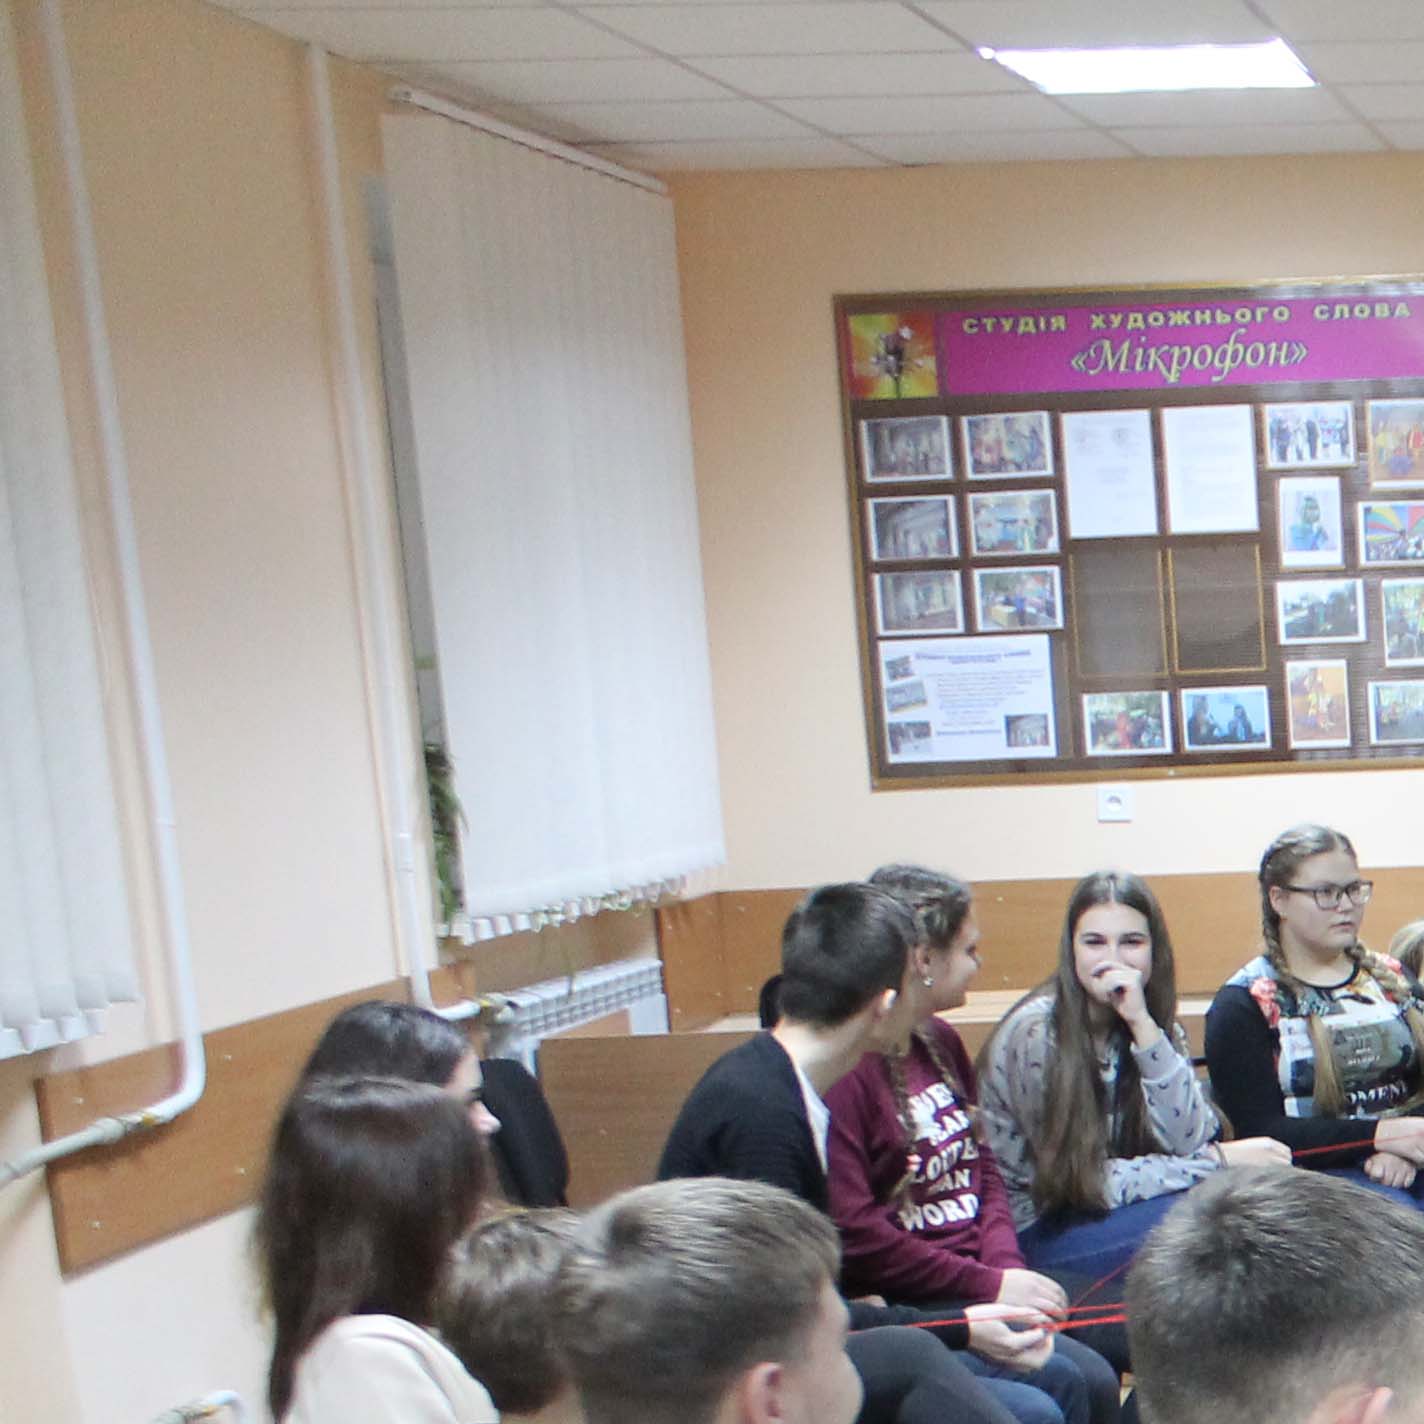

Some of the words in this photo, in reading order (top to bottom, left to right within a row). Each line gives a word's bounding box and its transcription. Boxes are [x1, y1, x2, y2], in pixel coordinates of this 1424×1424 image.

[962, 314, 1067, 334] СТУДІЯ
[1090, 305, 1291, 331] ХУДОЖНЬОГО
[1313, 302, 1411, 321] СЛОВА
[1071, 327, 1309, 383] «Мікрофон»
